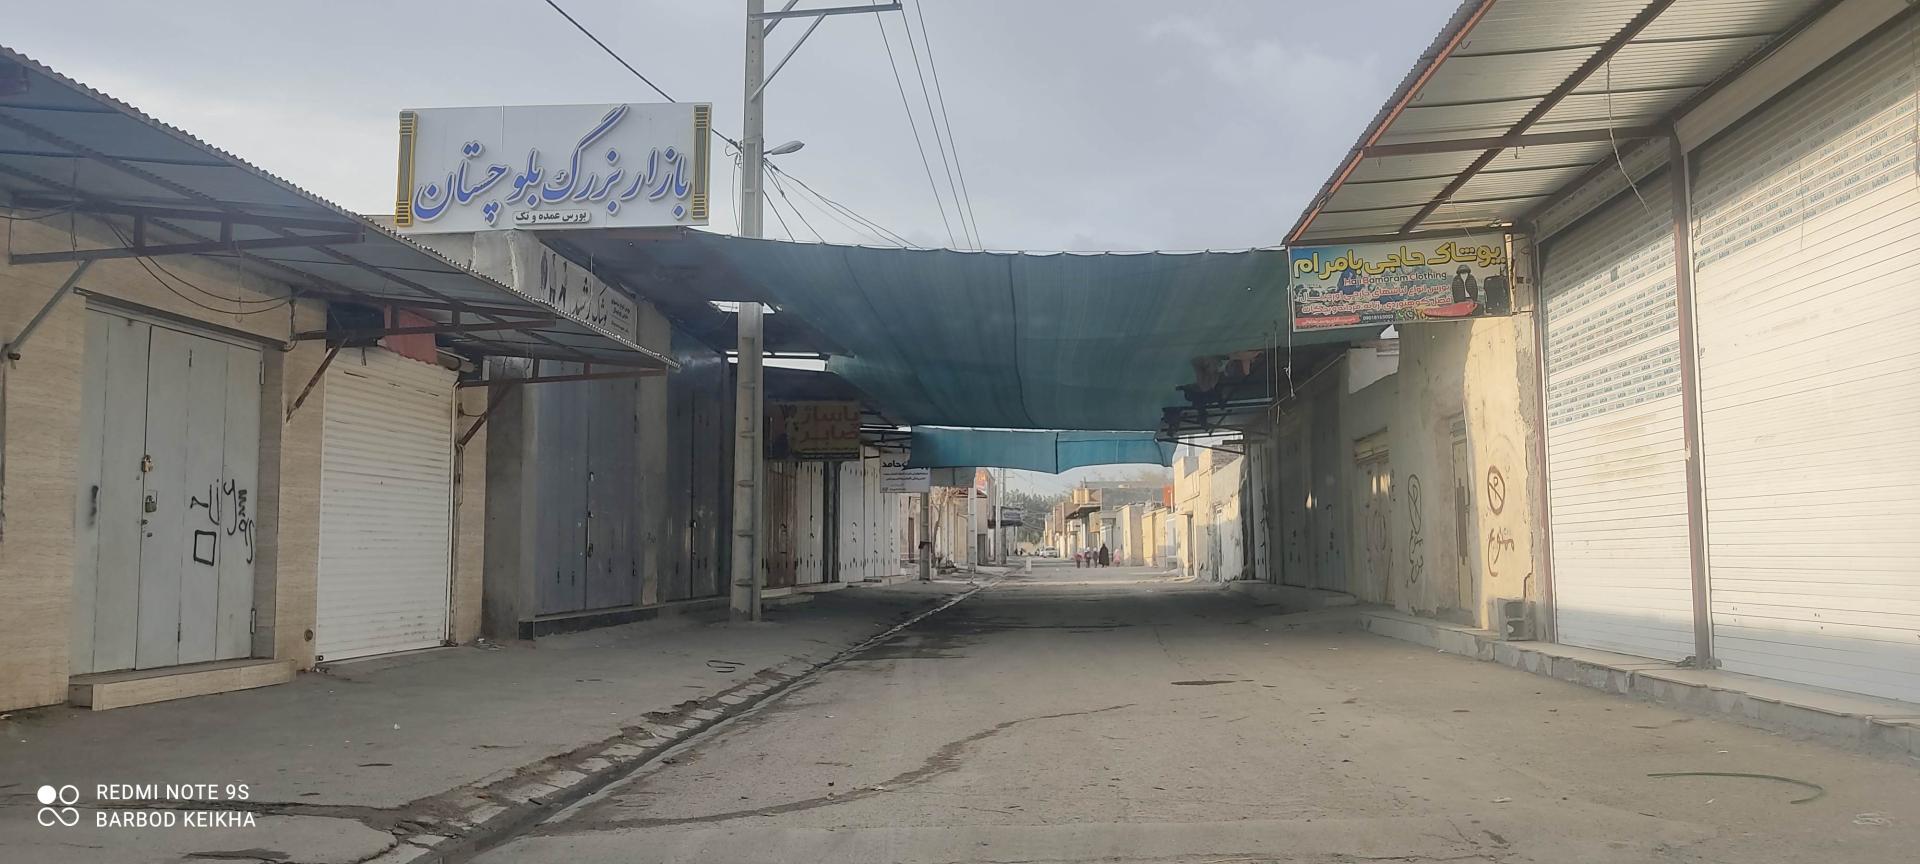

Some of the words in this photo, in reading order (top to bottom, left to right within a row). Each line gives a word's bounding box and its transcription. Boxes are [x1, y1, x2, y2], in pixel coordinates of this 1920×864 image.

[540, 104, 630, 216] بزرگ
[620, 147, 692, 219] بازار
[515, 211, 530, 220] تک
[531, 214, 537, 223] و
[538, 212, 560, 220] عمده
[562, 211, 587, 222] بورس
[1427, 242, 1508, 267] پوشاک
[1362, 246, 1426, 275] حاجی
[1409, 271, 1447, 281] Clothing
